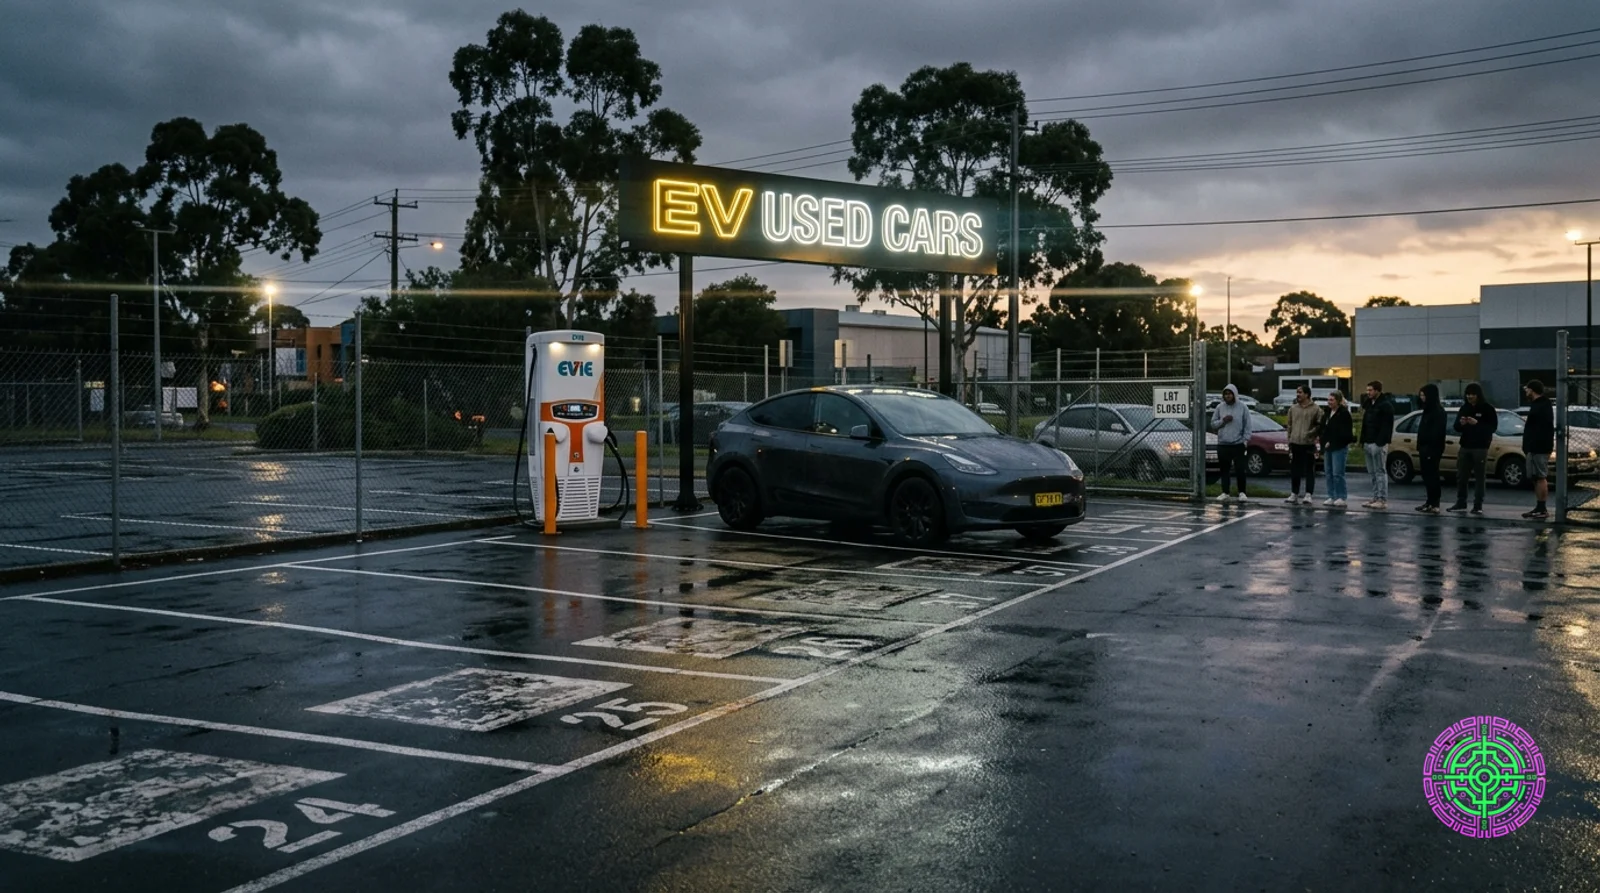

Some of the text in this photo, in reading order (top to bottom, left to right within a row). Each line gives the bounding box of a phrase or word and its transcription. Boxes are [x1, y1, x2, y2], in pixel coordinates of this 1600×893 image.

[653, 179, 984, 258] EV USED CARS
[558, 361, 593, 376] EVIE
[559, 697, 689, 731] 25
[207, 797, 397, 853] 24
